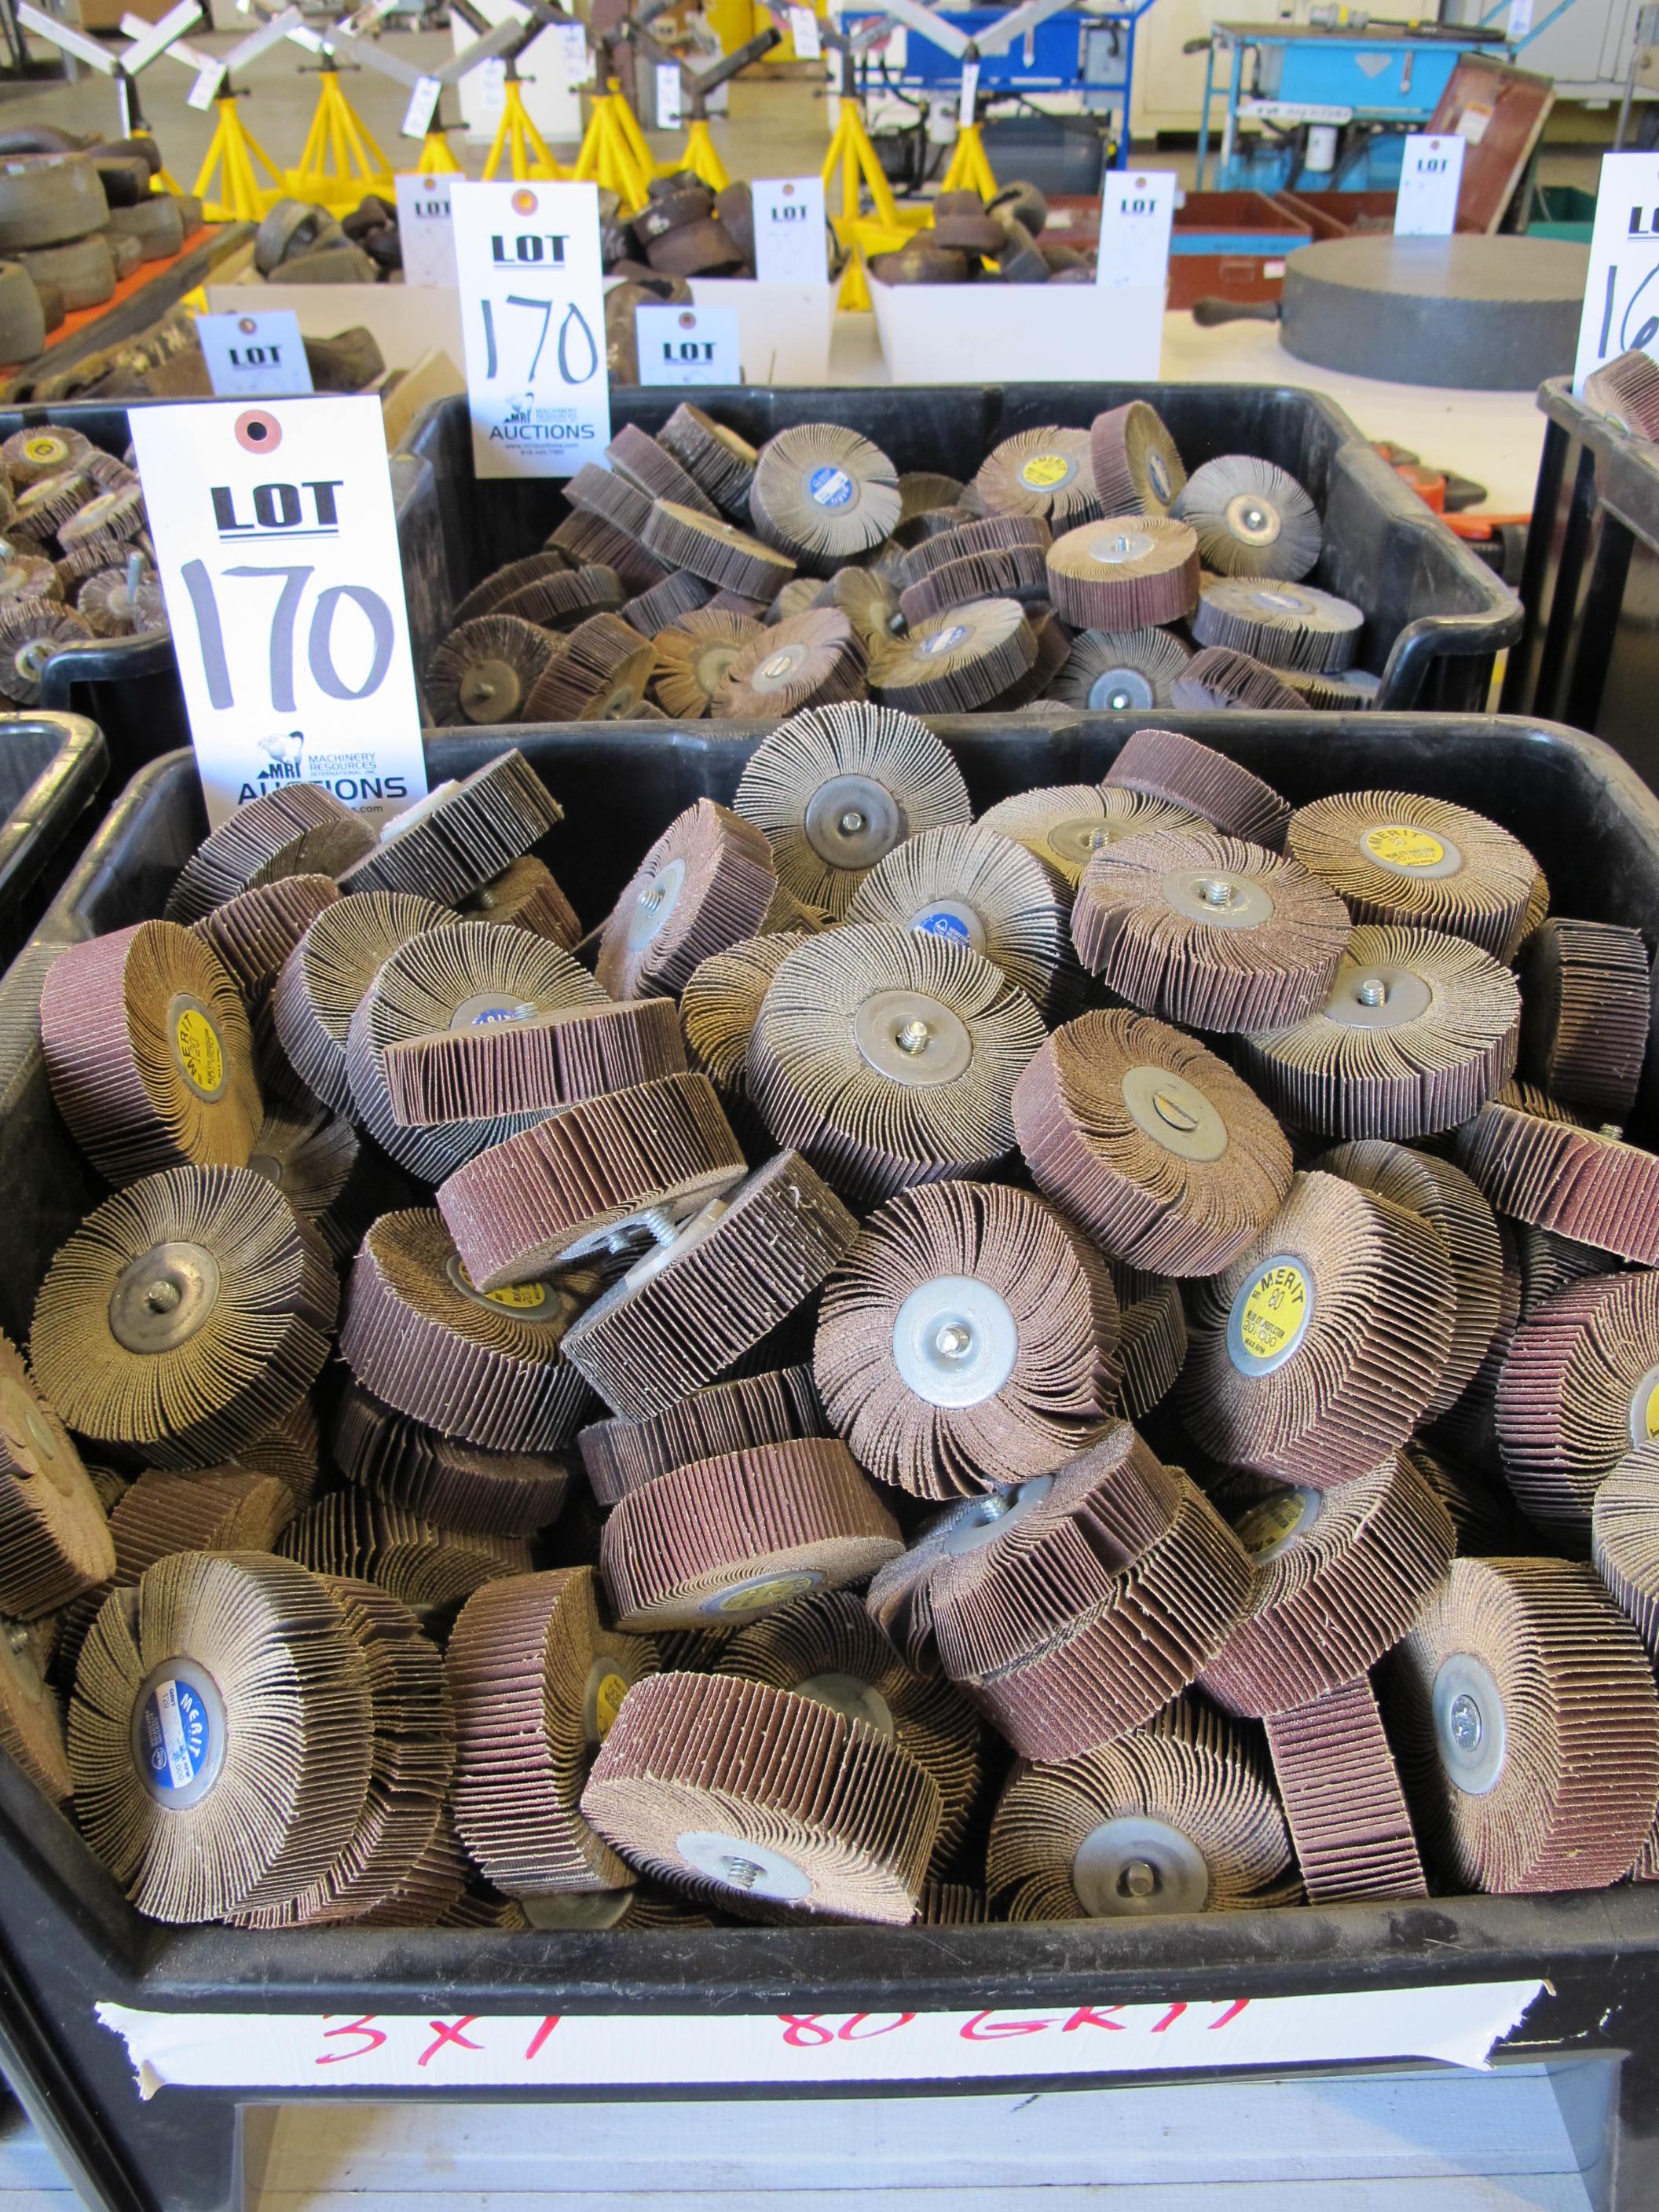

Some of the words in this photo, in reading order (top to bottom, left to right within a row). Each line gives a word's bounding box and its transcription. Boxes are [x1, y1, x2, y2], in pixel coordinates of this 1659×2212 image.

[1417, 159, 1448, 172] LOT
[415, 201, 450, 217] LOT
[771, 204, 807, 221] LOT
[1121, 199, 1157, 214] LOT
[491, 235, 570, 262] LOT
[481, 295, 599, 386] 170
[229, 346, 280, 366] LOT
[663, 342, 717, 361] LOT
[489, 425, 595, 440] AUCTIONS
[211, 480, 344, 531] LOT
[181, 558, 395, 713] 170
[308, 753, 375, 764] MACHINERY
[309, 761, 377, 772] RESOURCES
[269, 761, 302, 779] MRI
[237, 777, 408, 805] AIONS
[1368, 830, 1423, 844] MERIT
[180, 1013, 198, 1077] MERIT
[1261, 1269, 1304, 1303] MERIT
[1268, 1287, 1286, 1310] 80
[180, 1693, 203, 1757] MERIT
